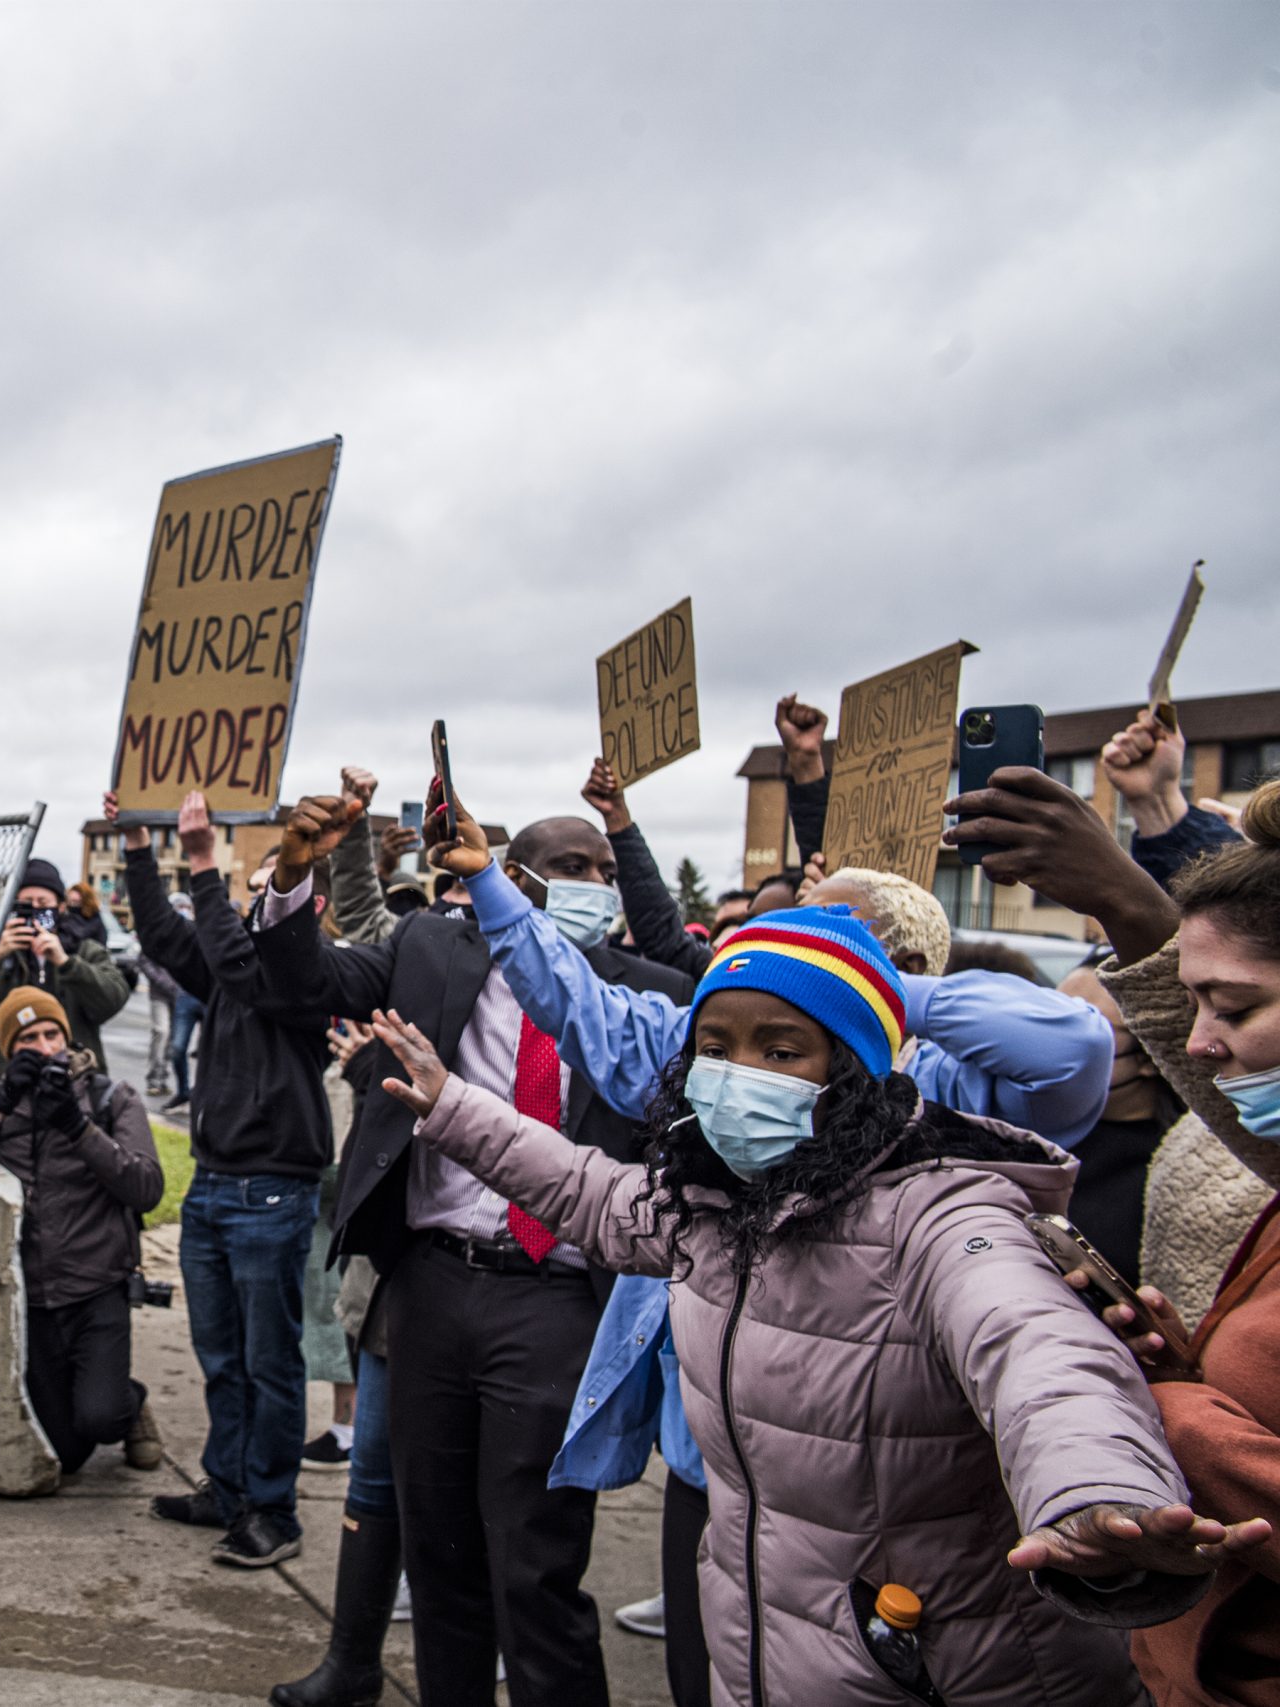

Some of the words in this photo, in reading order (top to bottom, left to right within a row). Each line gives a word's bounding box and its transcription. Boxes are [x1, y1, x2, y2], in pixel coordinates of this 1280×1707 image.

[144, 486, 329, 590] MURDER
[131, 600, 303, 684] MURDER
[597, 611, 686, 719] DEFUND
[115, 702, 288, 797] MURDER
[602, 682, 695, 781] POLICE
[836, 652, 956, 762] JUSTICE
[826, 758, 948, 849] DAUNTE
[866, 747, 902, 777] FOR
[832, 831, 941, 889] GHT
